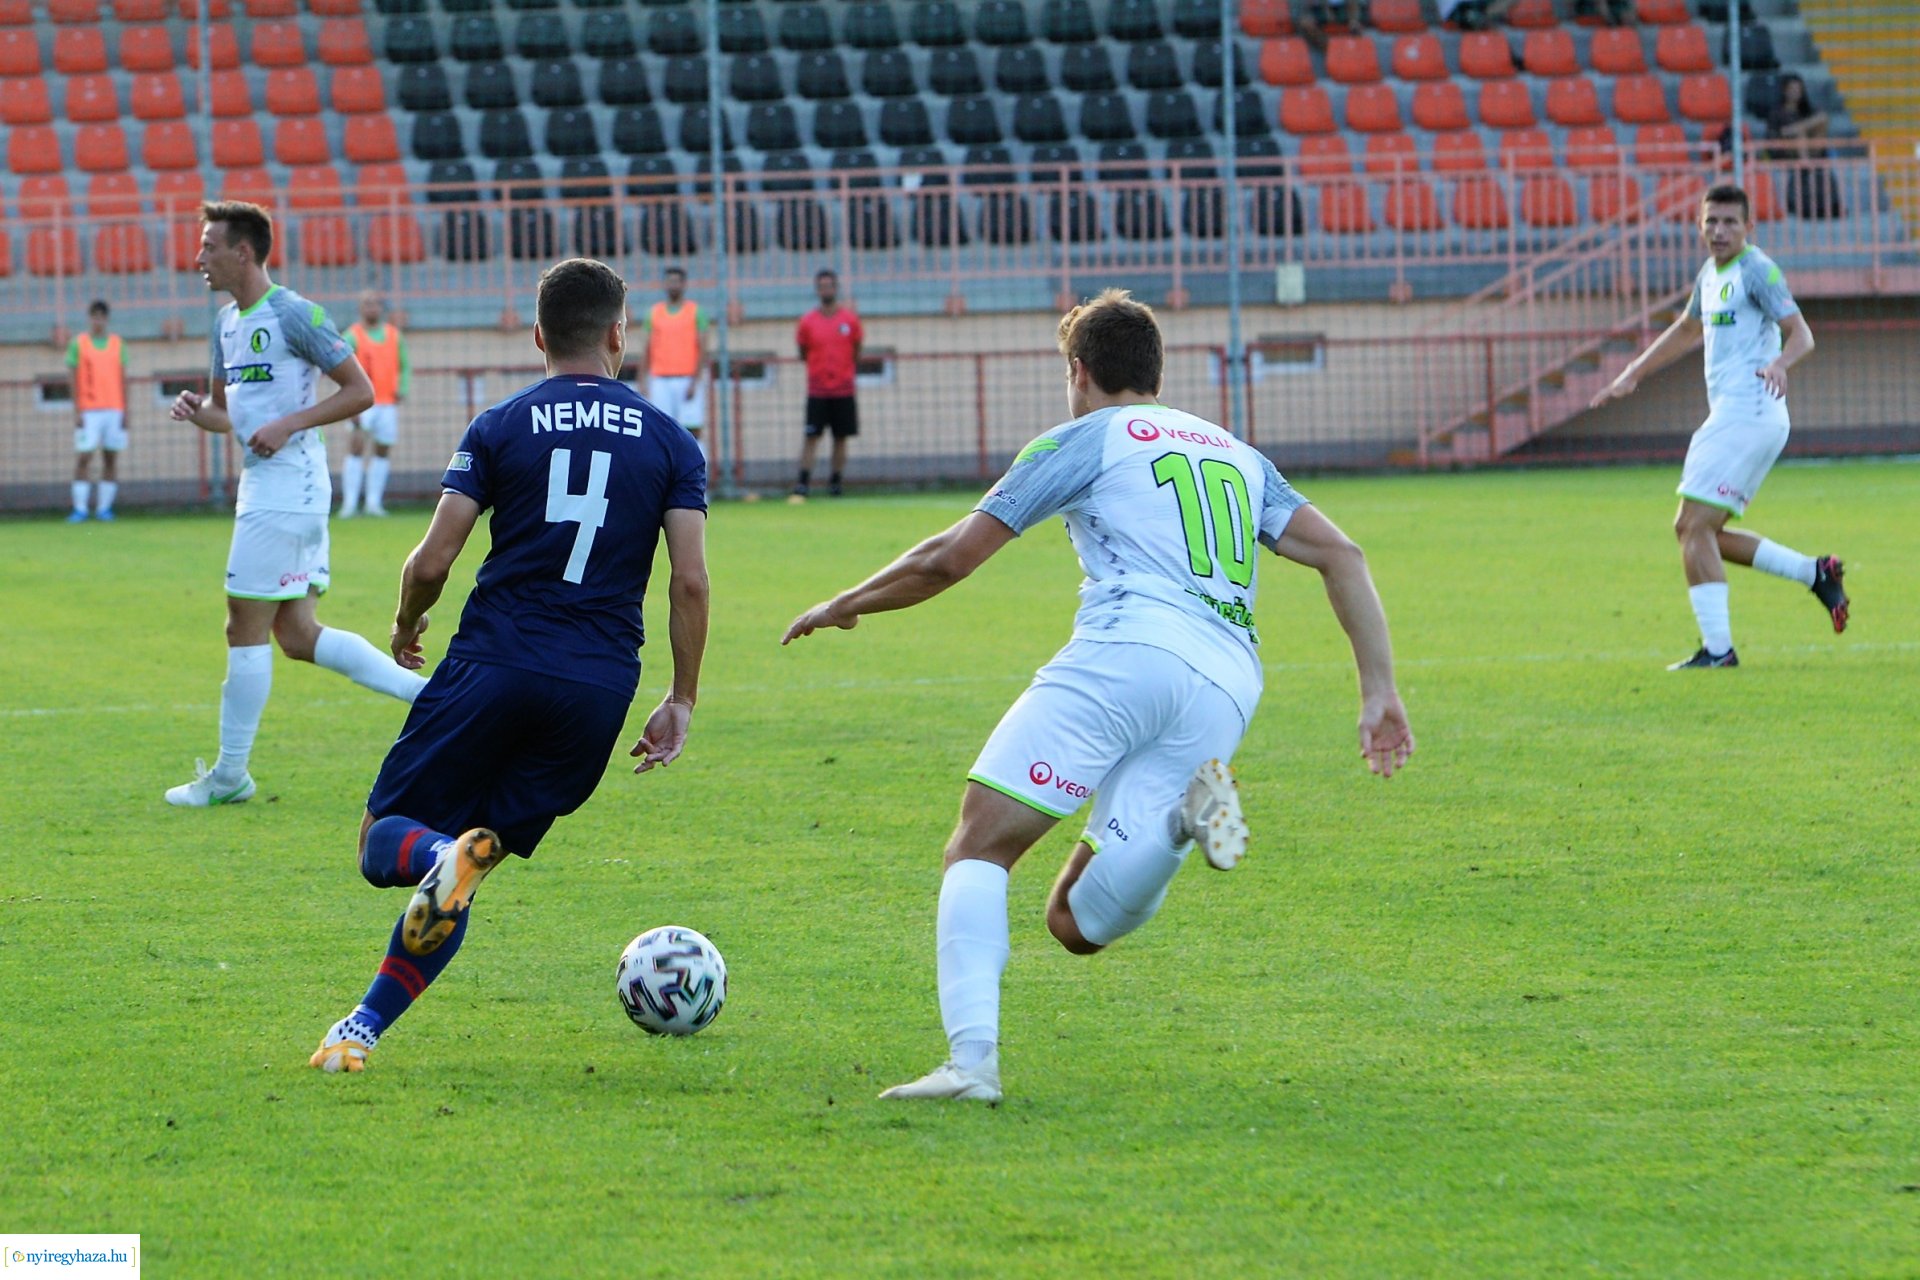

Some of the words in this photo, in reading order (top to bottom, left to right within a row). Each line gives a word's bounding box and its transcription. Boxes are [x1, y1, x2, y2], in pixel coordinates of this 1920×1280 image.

[530, 400, 643, 438] NEMES
[1161, 426, 1234, 450] VEOLIA
[545, 447, 612, 585] 4
[1151, 451, 1256, 589] 10
[1107, 817, 1129, 842] Das
